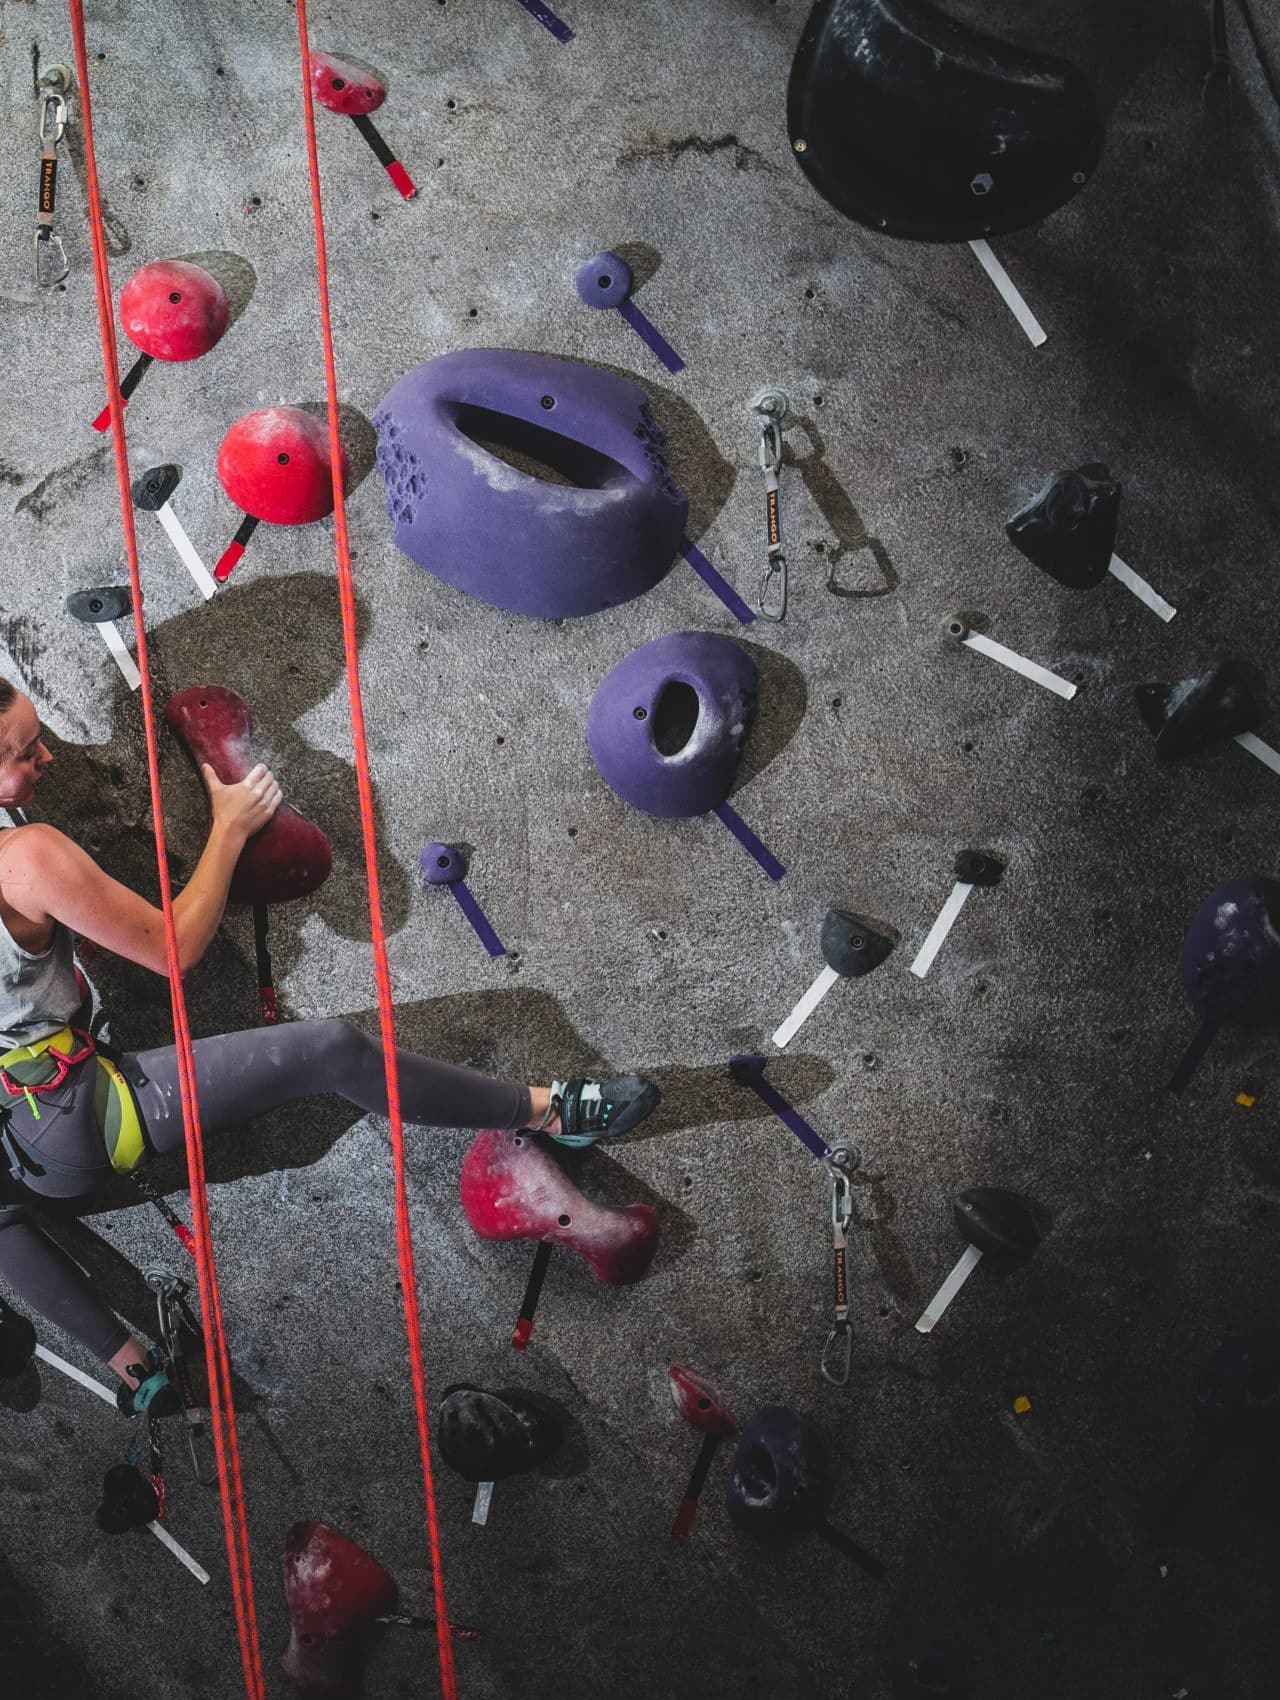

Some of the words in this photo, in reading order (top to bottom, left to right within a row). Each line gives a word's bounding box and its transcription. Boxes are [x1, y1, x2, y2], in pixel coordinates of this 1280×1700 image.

[44, 161, 53, 210] TRANGO
[769, 492, 777, 543] TRANGO
[836, 1250, 844, 1302] TRANGO
